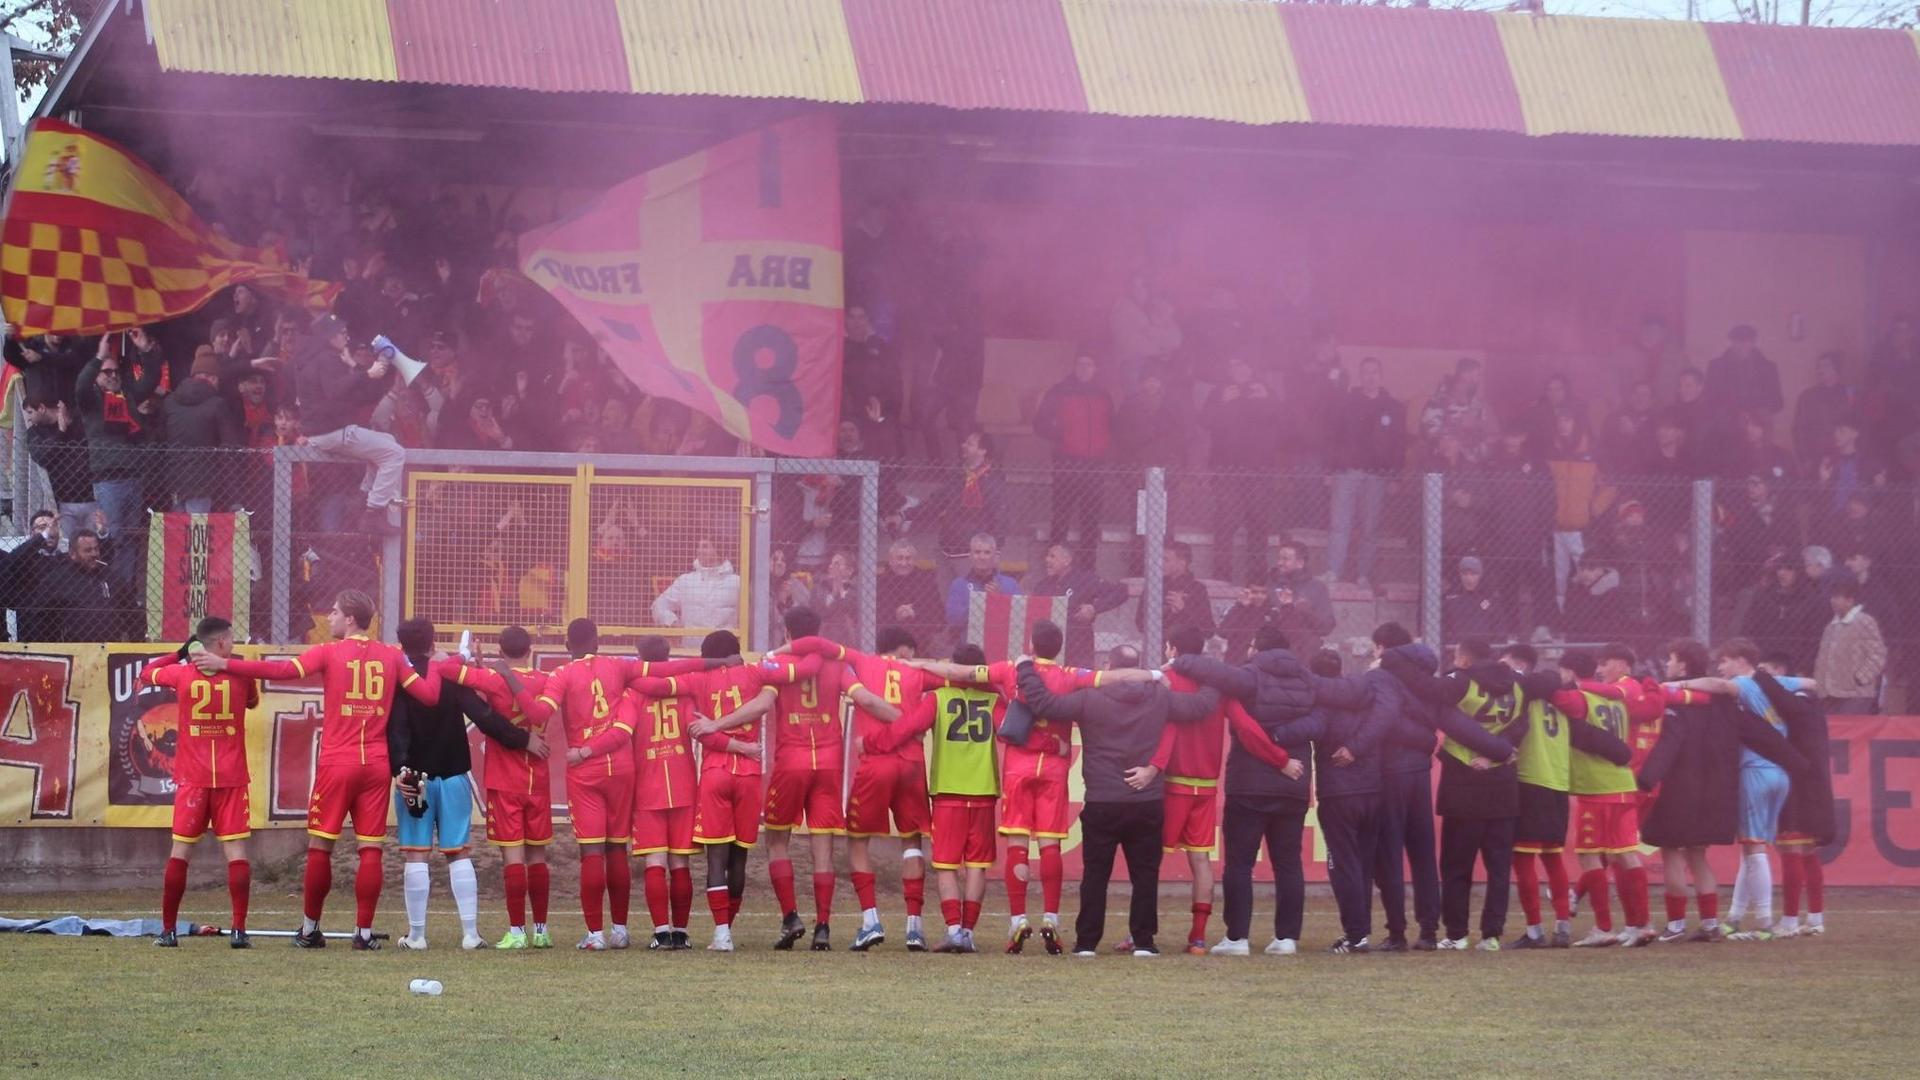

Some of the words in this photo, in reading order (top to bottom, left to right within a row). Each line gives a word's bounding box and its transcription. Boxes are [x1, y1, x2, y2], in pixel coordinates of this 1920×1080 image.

[184, 524, 215, 554] DOVE
[190, 679, 235, 720] 21
[345, 660, 384, 701] 16
[591, 679, 609, 719] 3
[884, 670, 902, 704] 6
[646, 698, 681, 742] 15
[711, 686, 742, 720] 11
[946, 697, 993, 743] 25
